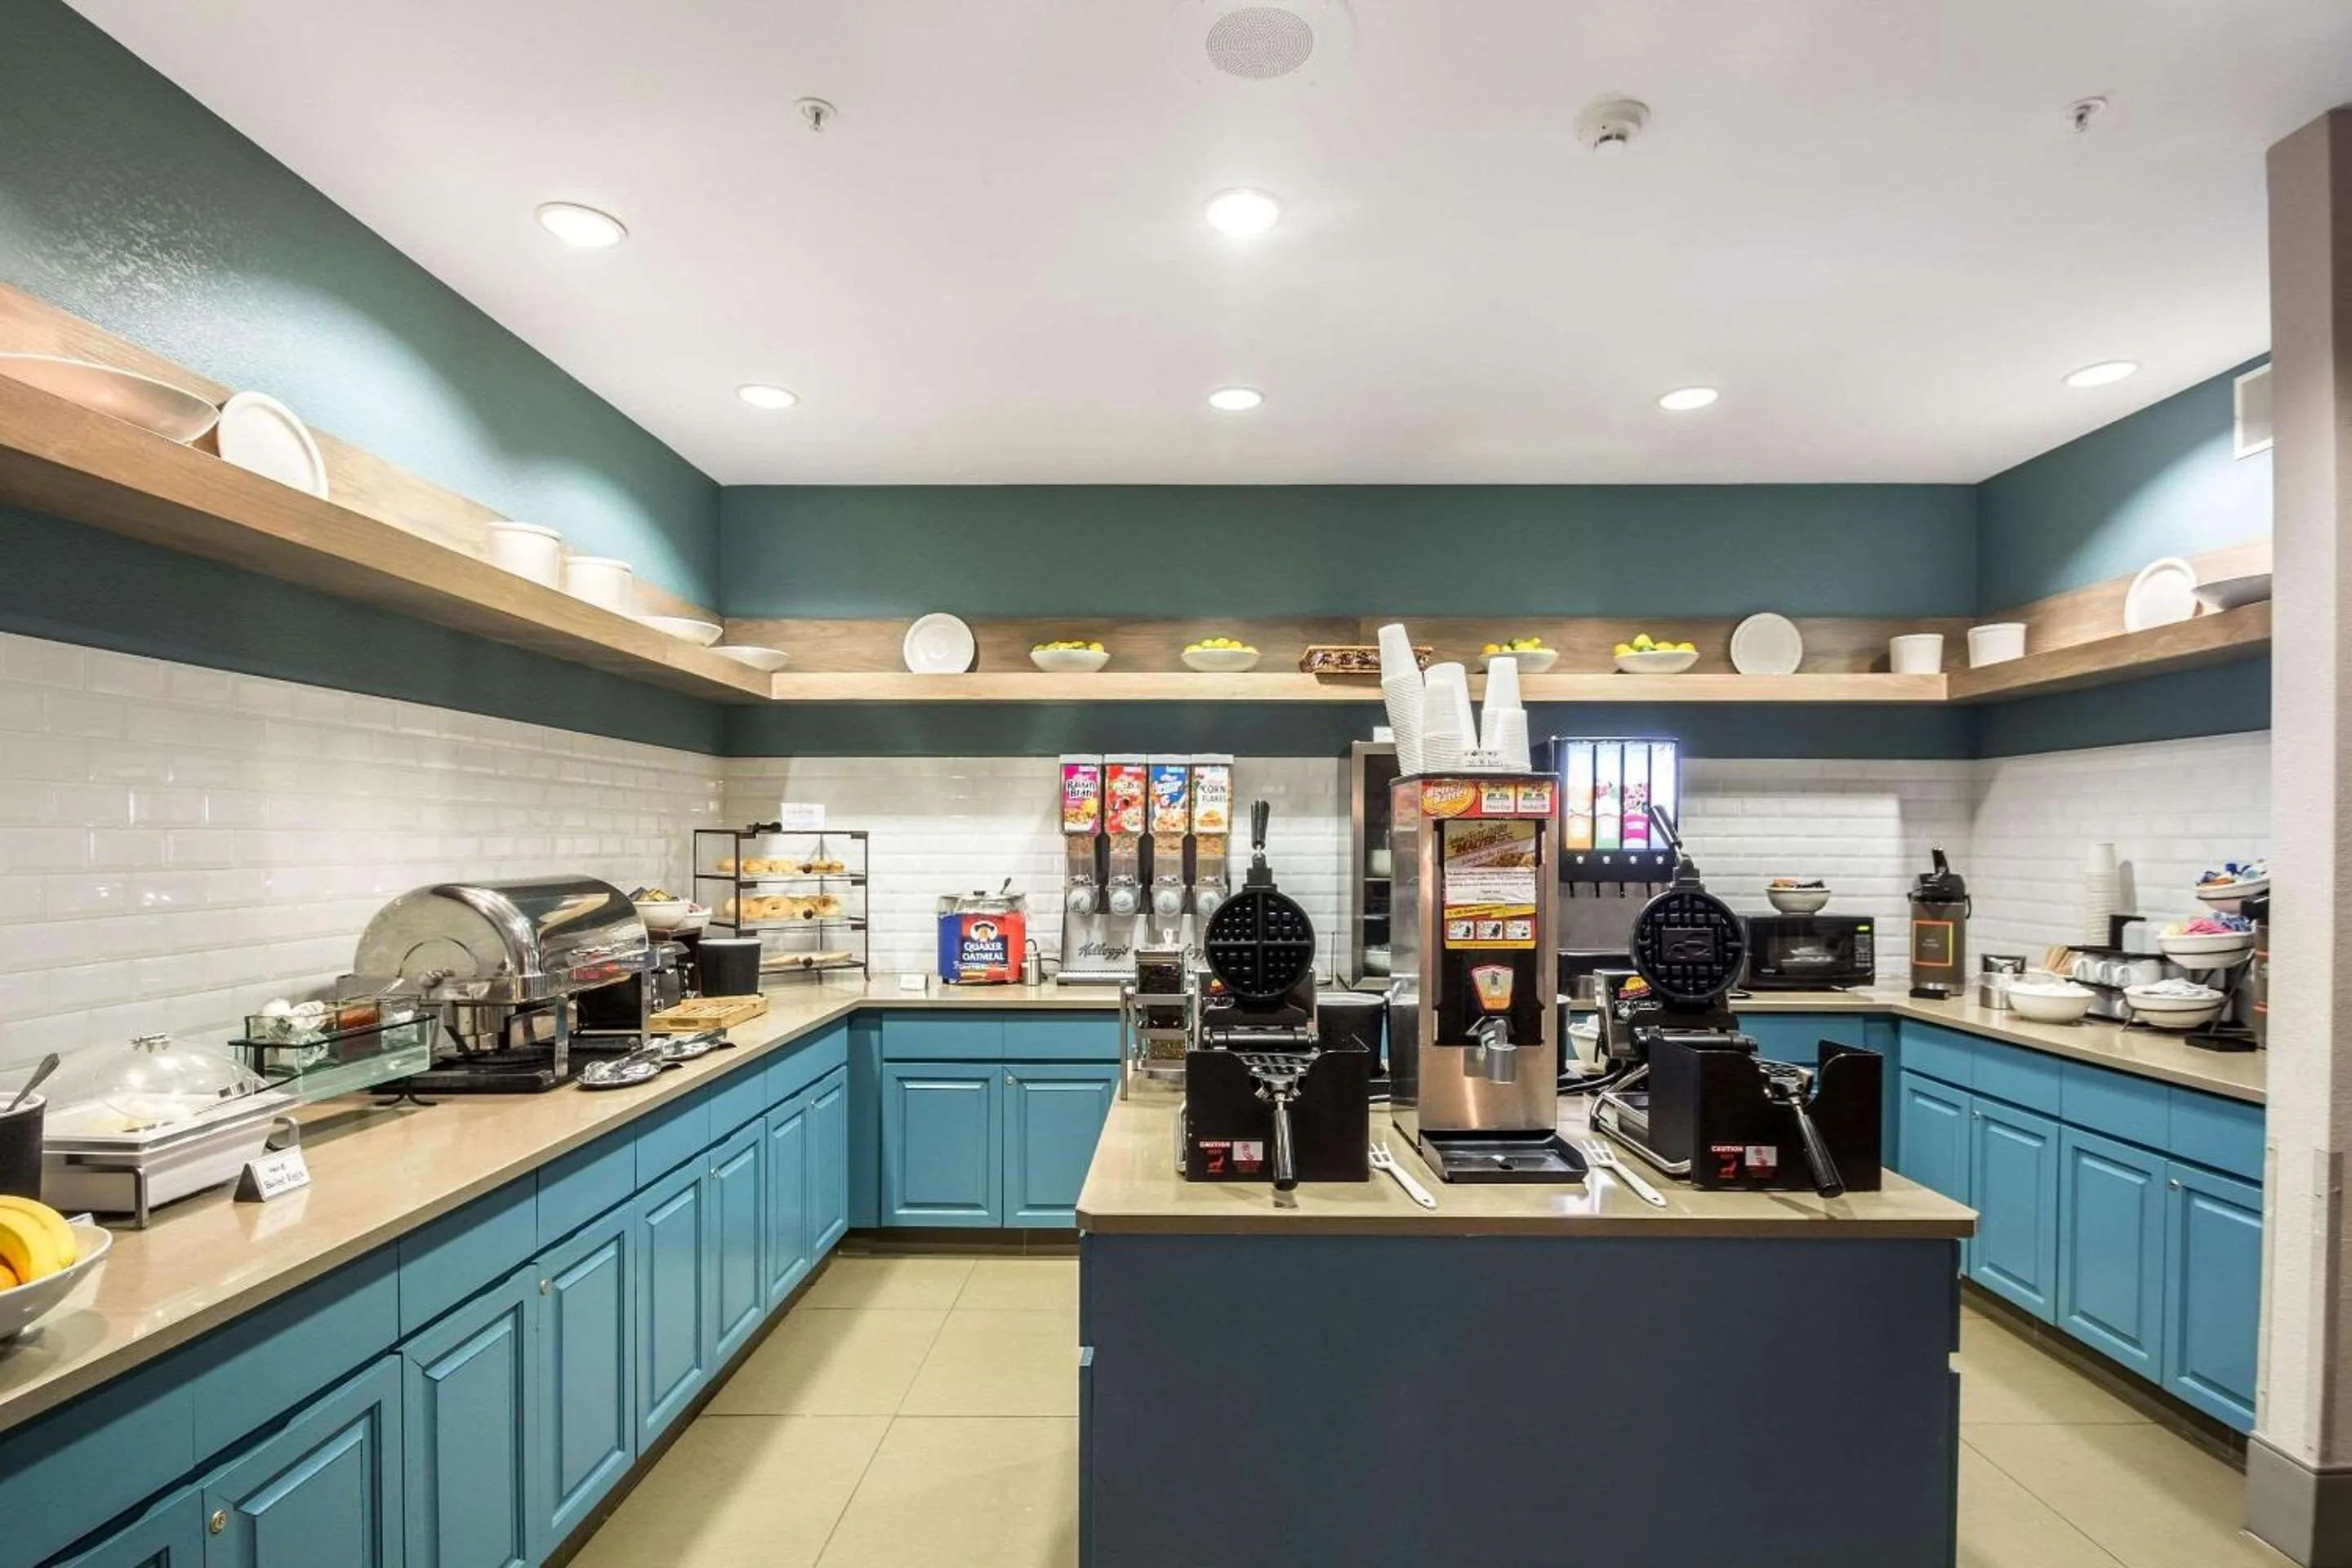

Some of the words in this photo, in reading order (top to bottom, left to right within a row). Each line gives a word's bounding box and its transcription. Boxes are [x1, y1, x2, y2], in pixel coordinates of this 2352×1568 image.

[1067, 780, 1097, 791] Raisin
[1070, 788, 1093, 798] Bran
[964, 942, 1003, 952] QUAKER
[1079, 942, 1129, 961] Kellogg's
[962, 952, 1004, 961] OATMEAL
